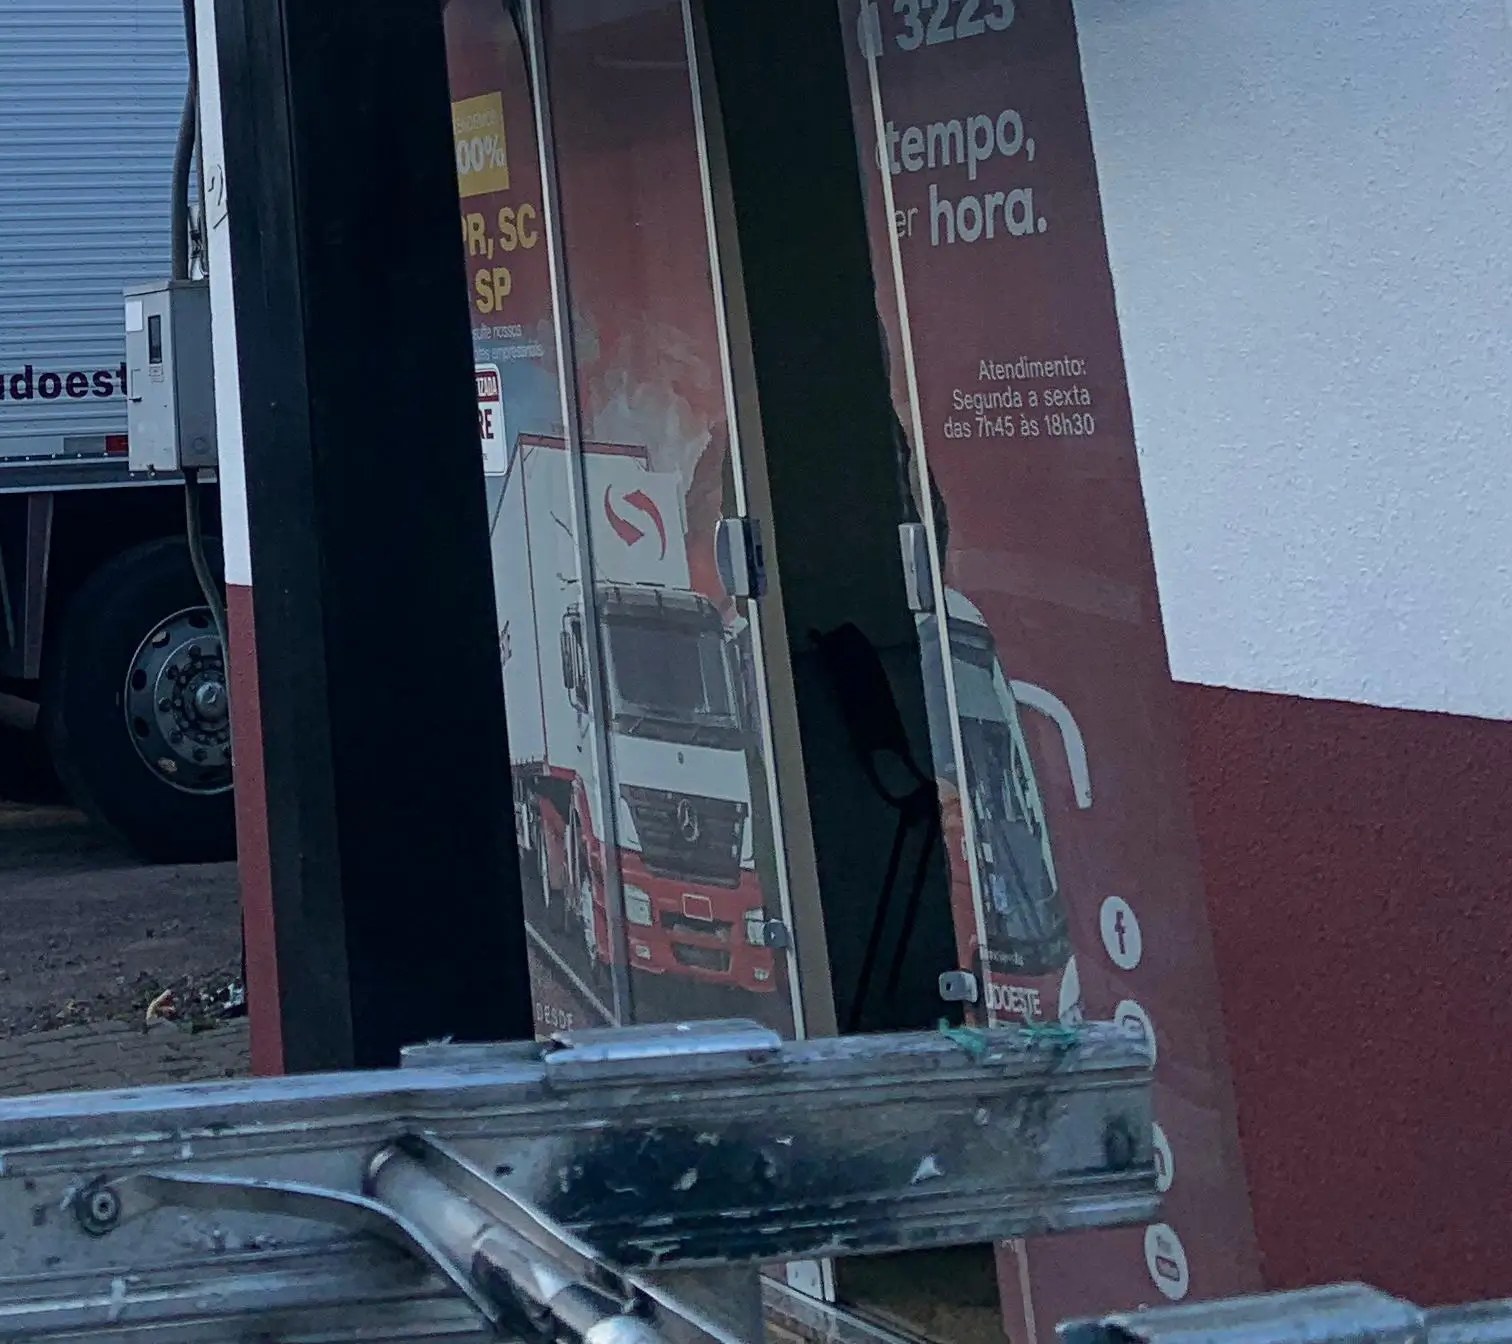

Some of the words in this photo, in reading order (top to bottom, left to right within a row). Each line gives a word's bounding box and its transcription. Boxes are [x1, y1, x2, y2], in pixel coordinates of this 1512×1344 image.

[886, 109, 1036, 180] tempo,
[498, 203, 539, 252] SC
[928, 183, 1048, 246] hora.
[475, 266, 512, 314] SP
[978, 355, 1088, 381] Atendimento:
[952, 385, 1023, 415] Segunda
[1028, 389, 1038, 407] a
[1044, 383, 1091, 406] sexta
[944, 416, 972, 438] das
[975, 414, 1015, 438] 7h45
[1020, 413, 1040, 436] às
[1044, 411, 1095, 436] 18h30
